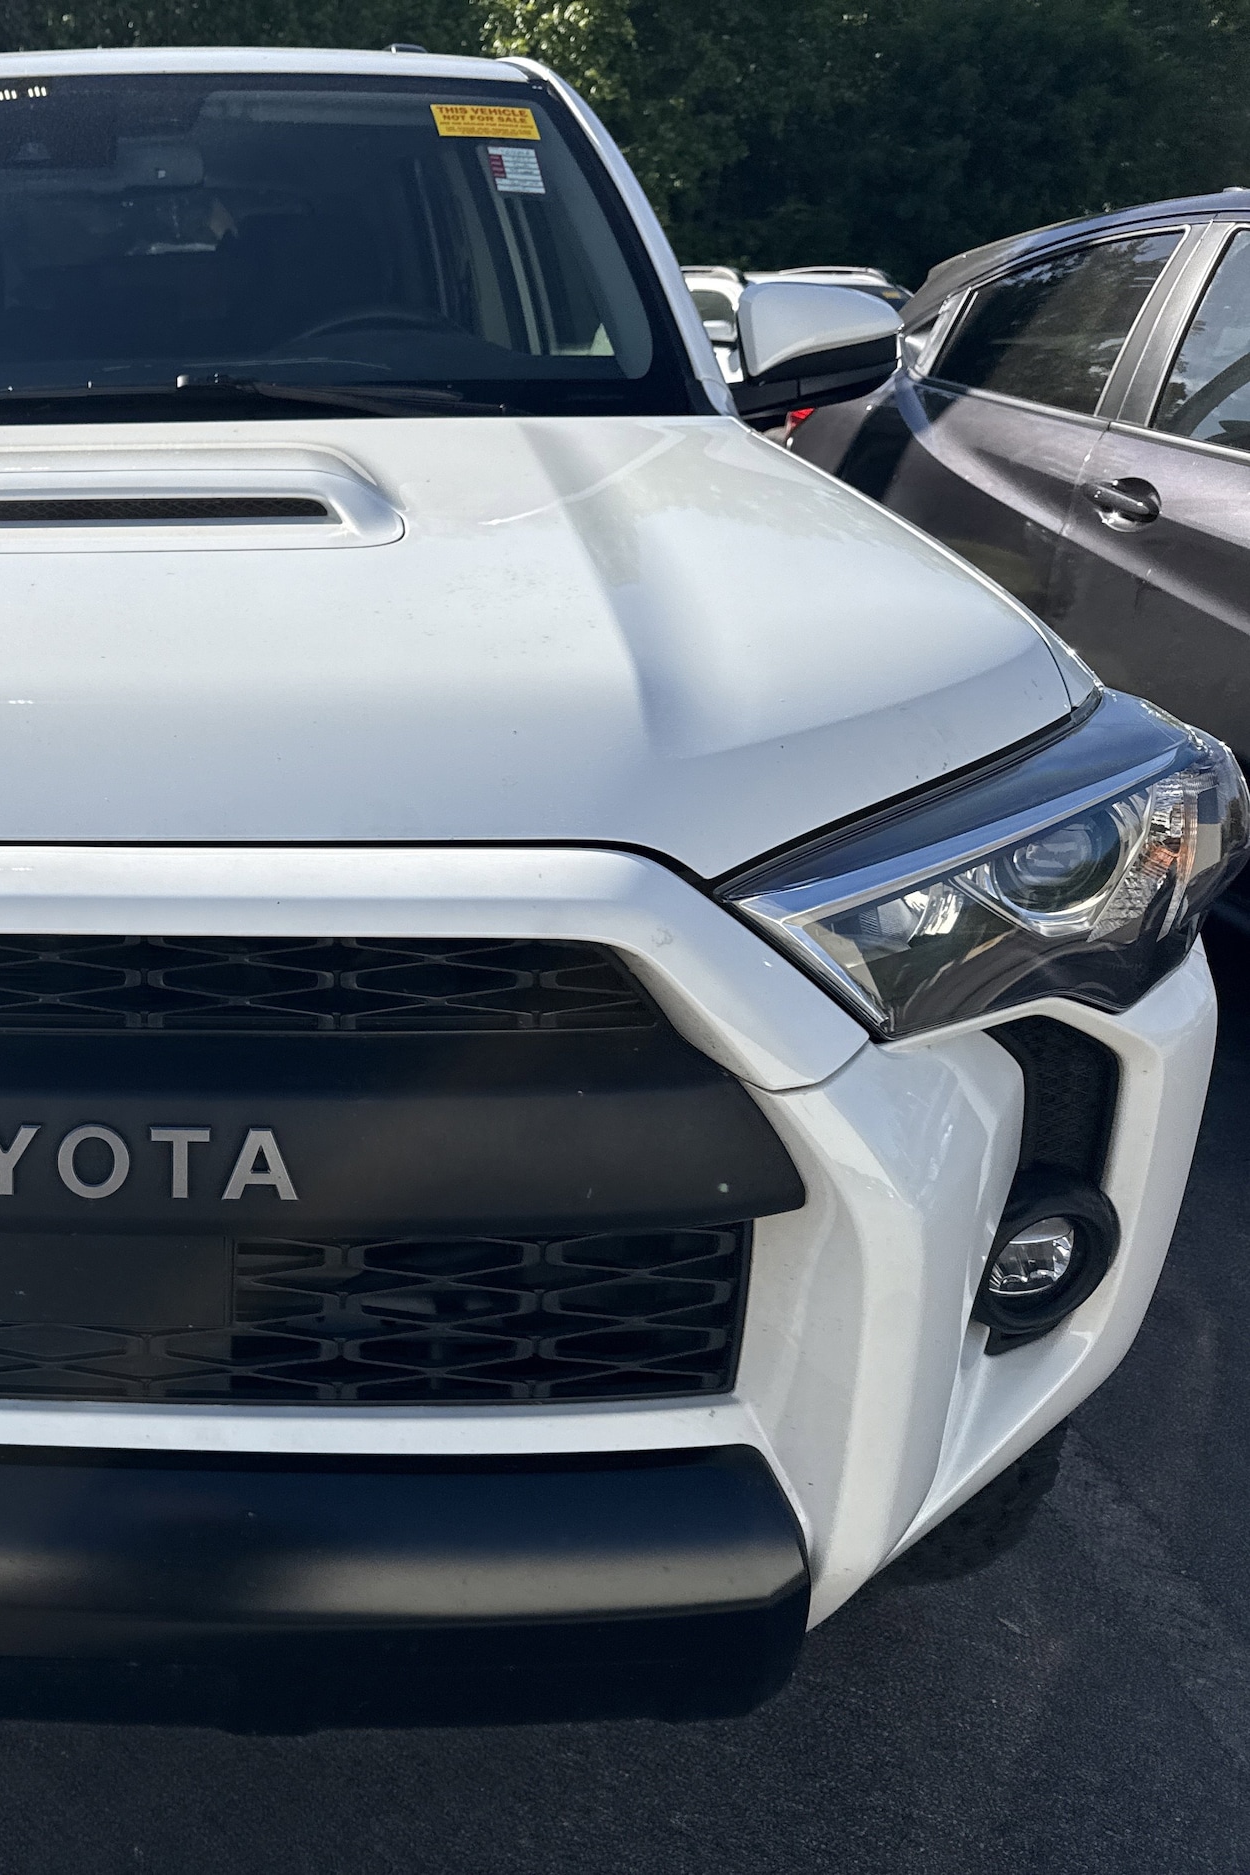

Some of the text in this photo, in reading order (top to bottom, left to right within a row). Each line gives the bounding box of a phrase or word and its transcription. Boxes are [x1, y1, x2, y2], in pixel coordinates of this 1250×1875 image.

[436, 106, 528, 117] THIS VEHICLE
[497, 116, 528, 124] SALE
